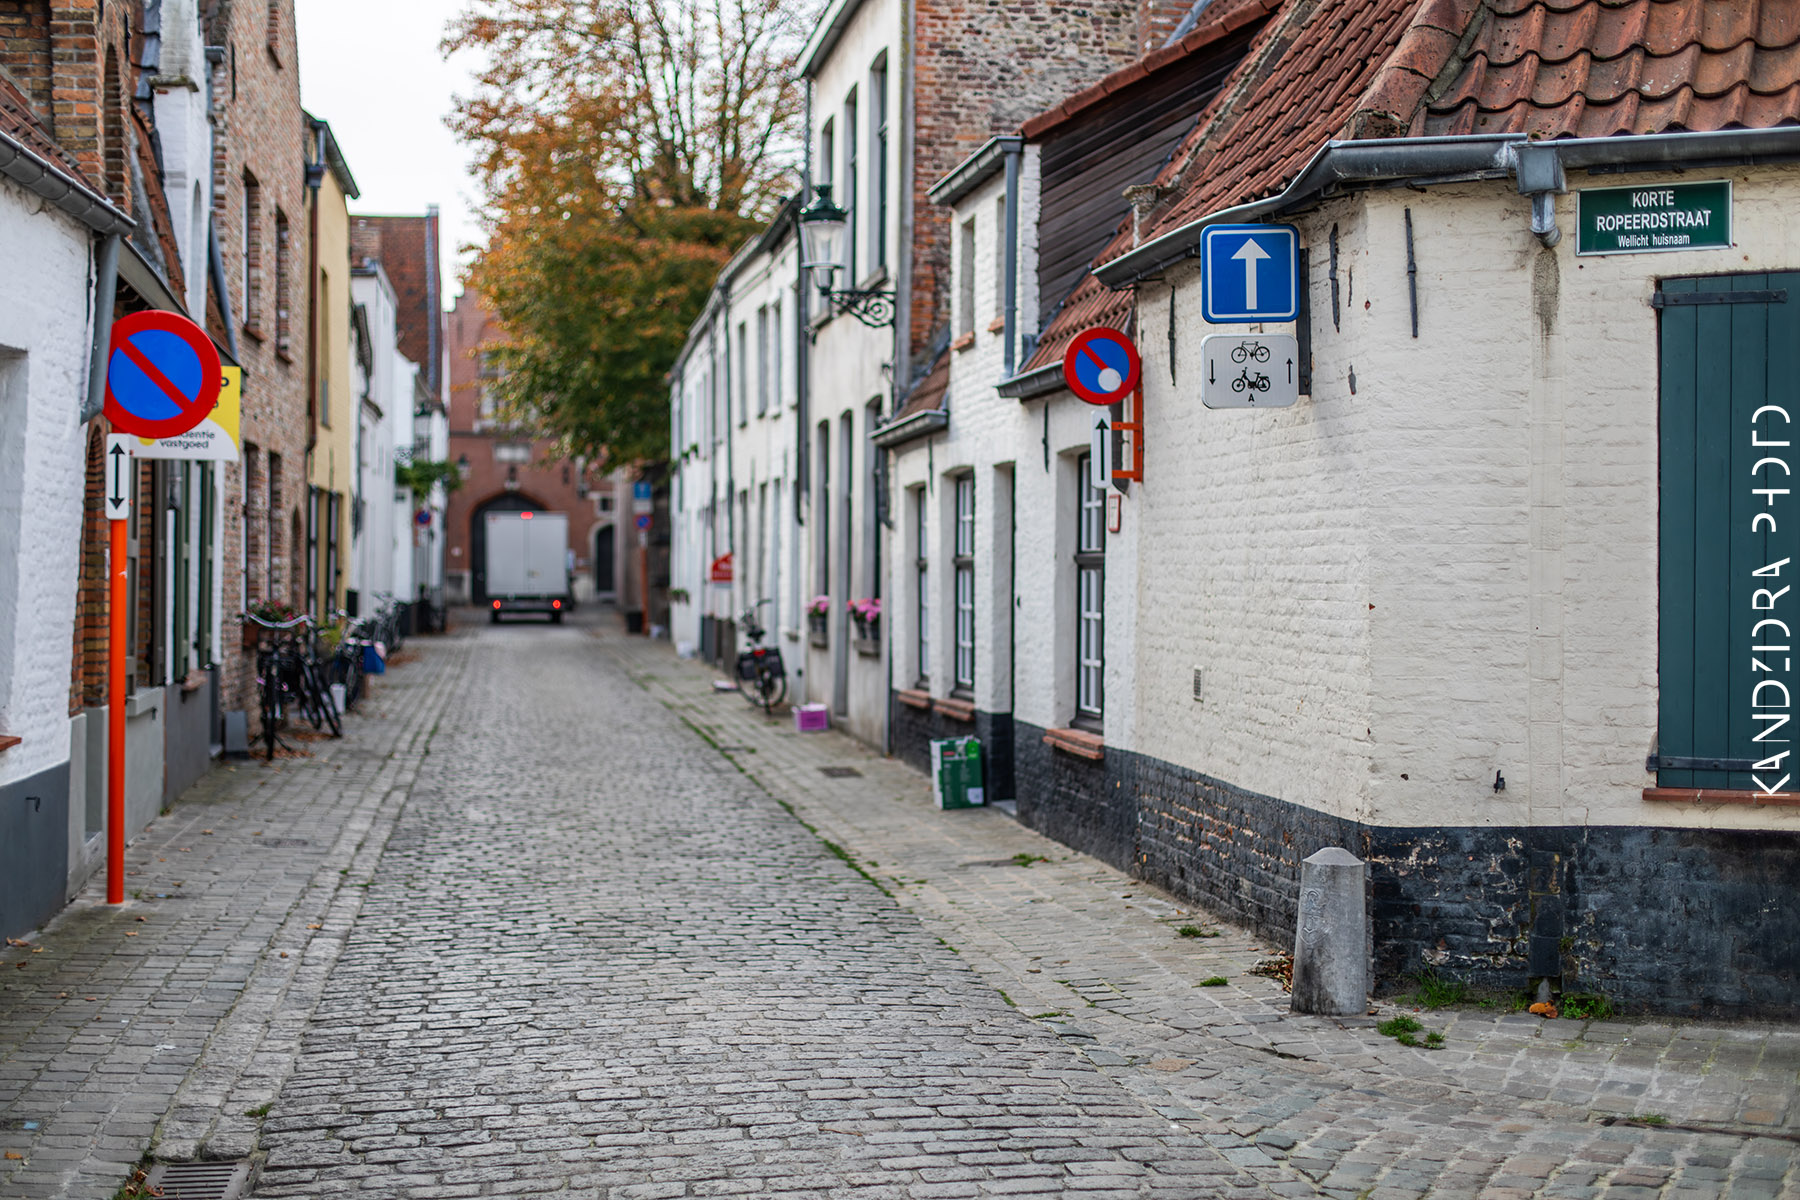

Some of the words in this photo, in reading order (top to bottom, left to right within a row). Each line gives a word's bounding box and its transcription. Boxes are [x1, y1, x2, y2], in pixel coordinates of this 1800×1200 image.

[1632, 190, 1675, 208] KORTE
[1596, 210, 1711, 232] ROPEERDSTRAAT
[1618, 234, 1649, 248] Wellicht
[1652, 233, 1690, 246] huisnaam
[1248, 393, 1255, 402] A
